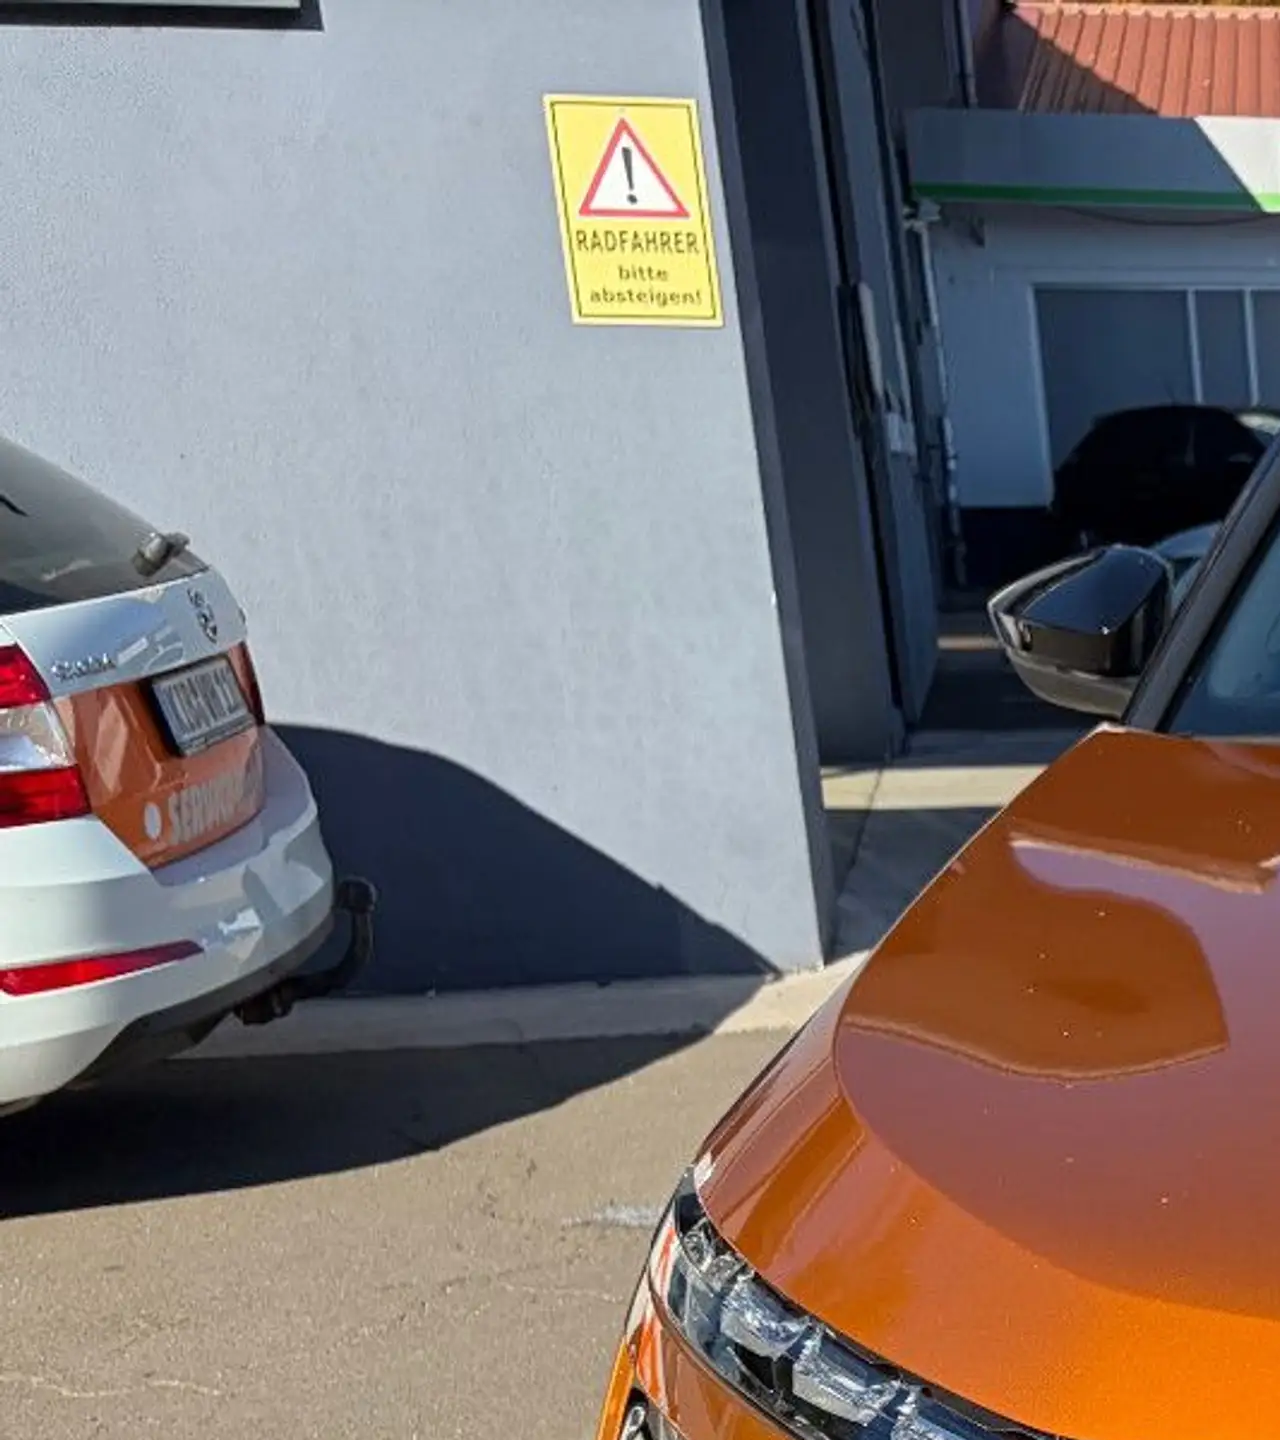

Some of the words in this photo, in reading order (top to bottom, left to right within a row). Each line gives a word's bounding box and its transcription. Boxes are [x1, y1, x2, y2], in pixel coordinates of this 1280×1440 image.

[575, 229, 700, 254] RADFAHRER
[617, 264, 670, 282] bitte
[590, 287, 703, 307] absteigen!
